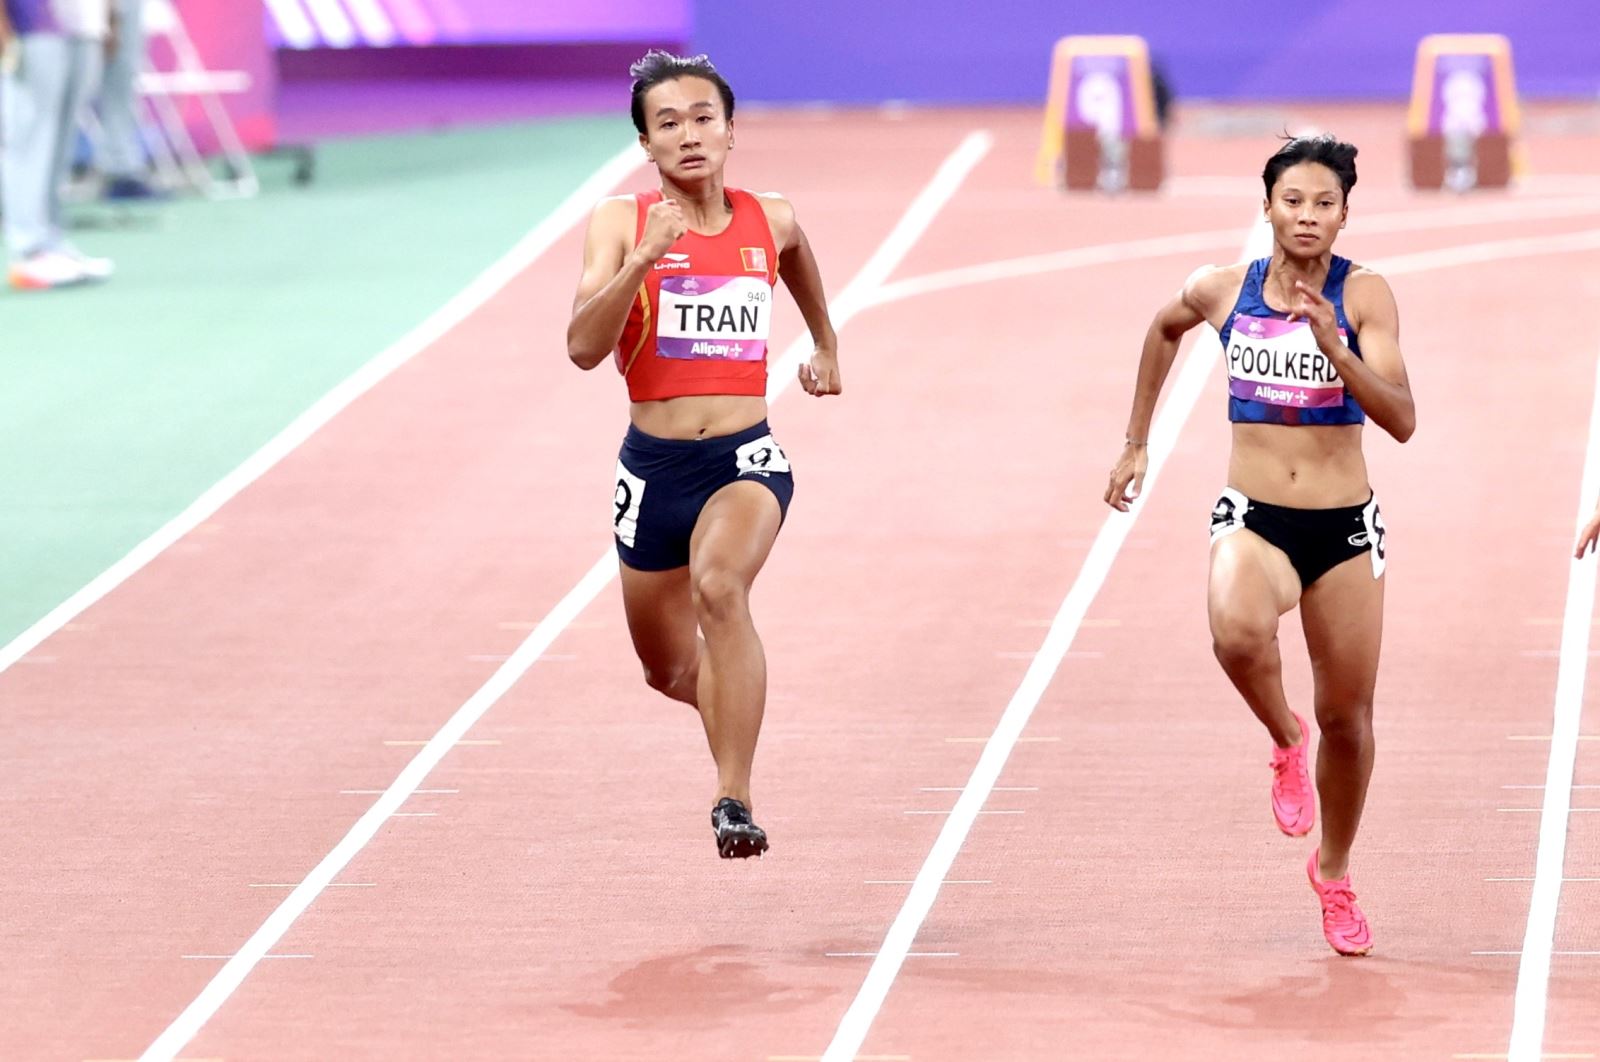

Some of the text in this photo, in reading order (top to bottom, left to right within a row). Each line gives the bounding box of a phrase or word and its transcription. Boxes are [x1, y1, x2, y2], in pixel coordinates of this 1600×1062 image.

[747, 292, 766, 302] 940
[674, 304, 759, 333] TRAN
[1230, 344, 1339, 382] POOLKERD
[748, 447, 772, 468] 9
[614, 478, 632, 527] 9
